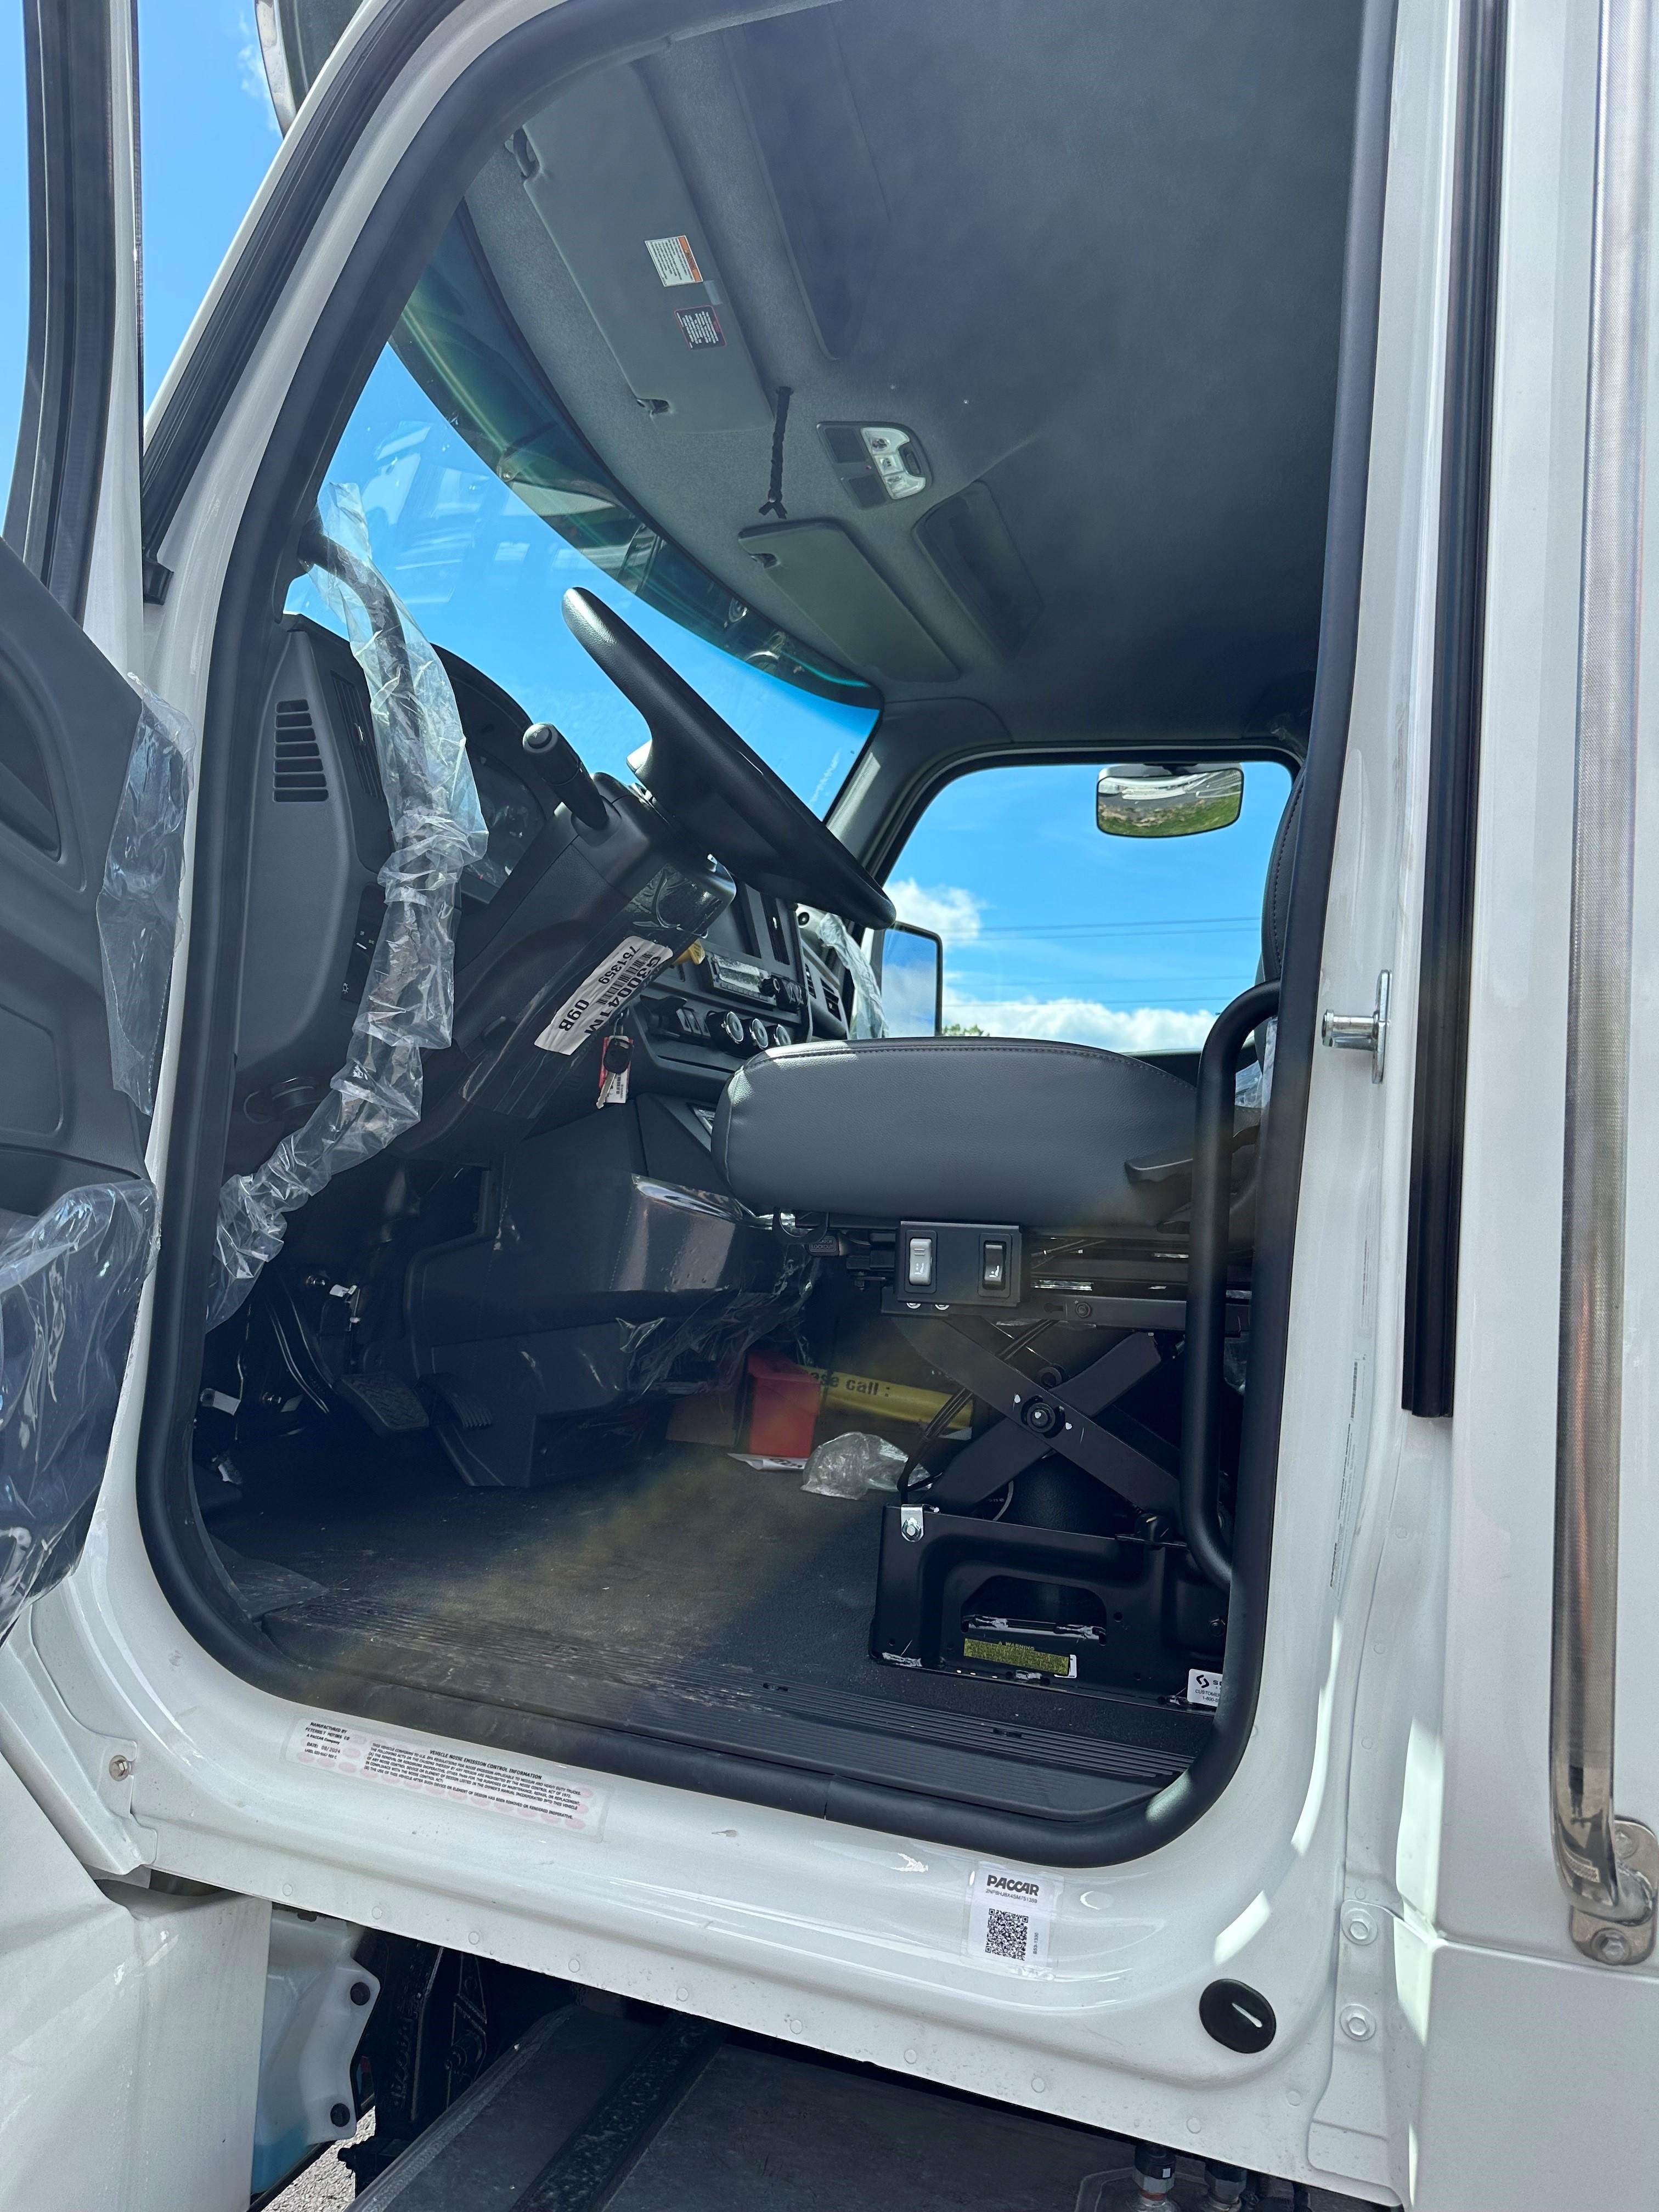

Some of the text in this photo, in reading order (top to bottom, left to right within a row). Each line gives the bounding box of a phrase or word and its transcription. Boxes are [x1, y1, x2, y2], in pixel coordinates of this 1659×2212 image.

[598, 946, 641, 984] 751359
[558, 1000, 589, 1031] 09B
[845, 1379, 879, 1395] call
[1005, 1641, 1035, 1651] WARNING
[430, 1750, 449, 1758] VEHICLE
[464, 1758, 487, 1767] EMISSION
[487, 1763, 509, 1772] CONTROL
[509, 1768, 542, 1780] INFORMATION
[986, 1874, 1039, 1896] PACCAR
